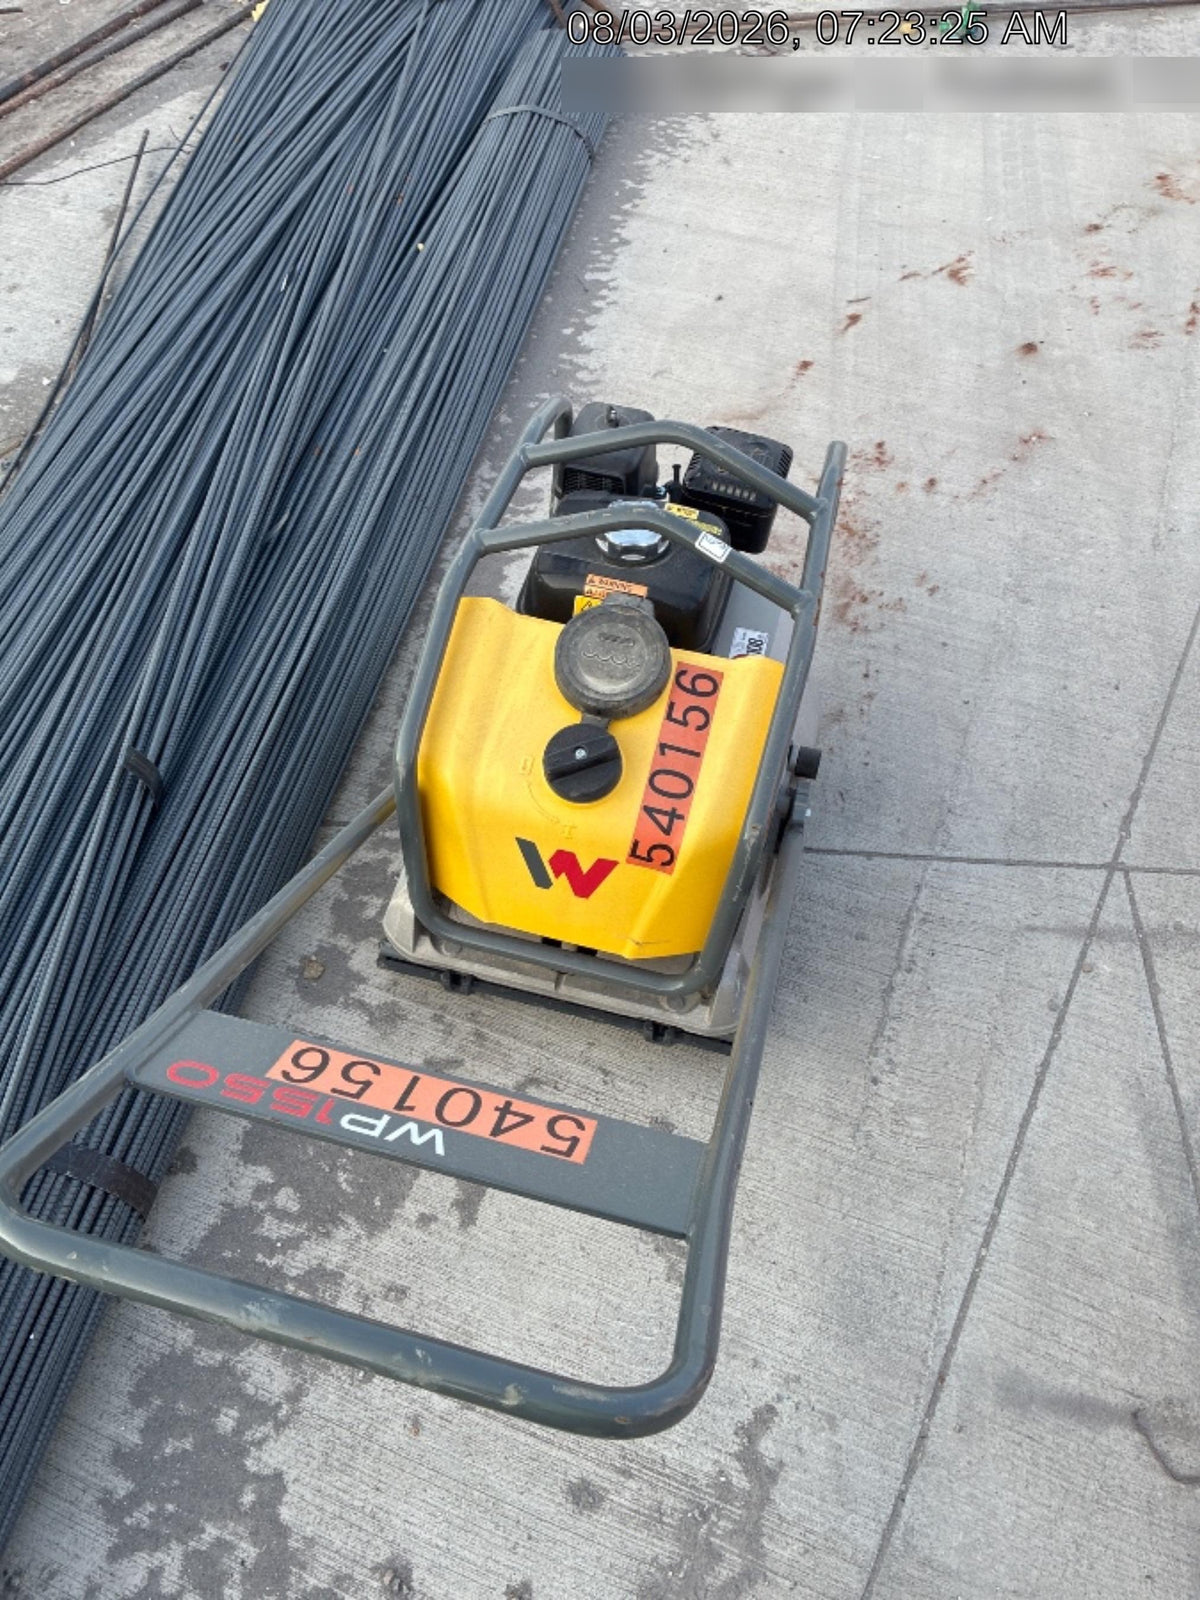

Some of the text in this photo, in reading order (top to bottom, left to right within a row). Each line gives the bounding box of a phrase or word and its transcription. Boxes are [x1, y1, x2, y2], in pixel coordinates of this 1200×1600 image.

[630, 669, 719, 867] 540156
[166, 1061, 450, 1156] WP1550
[280, 1045, 588, 1158] 540156
